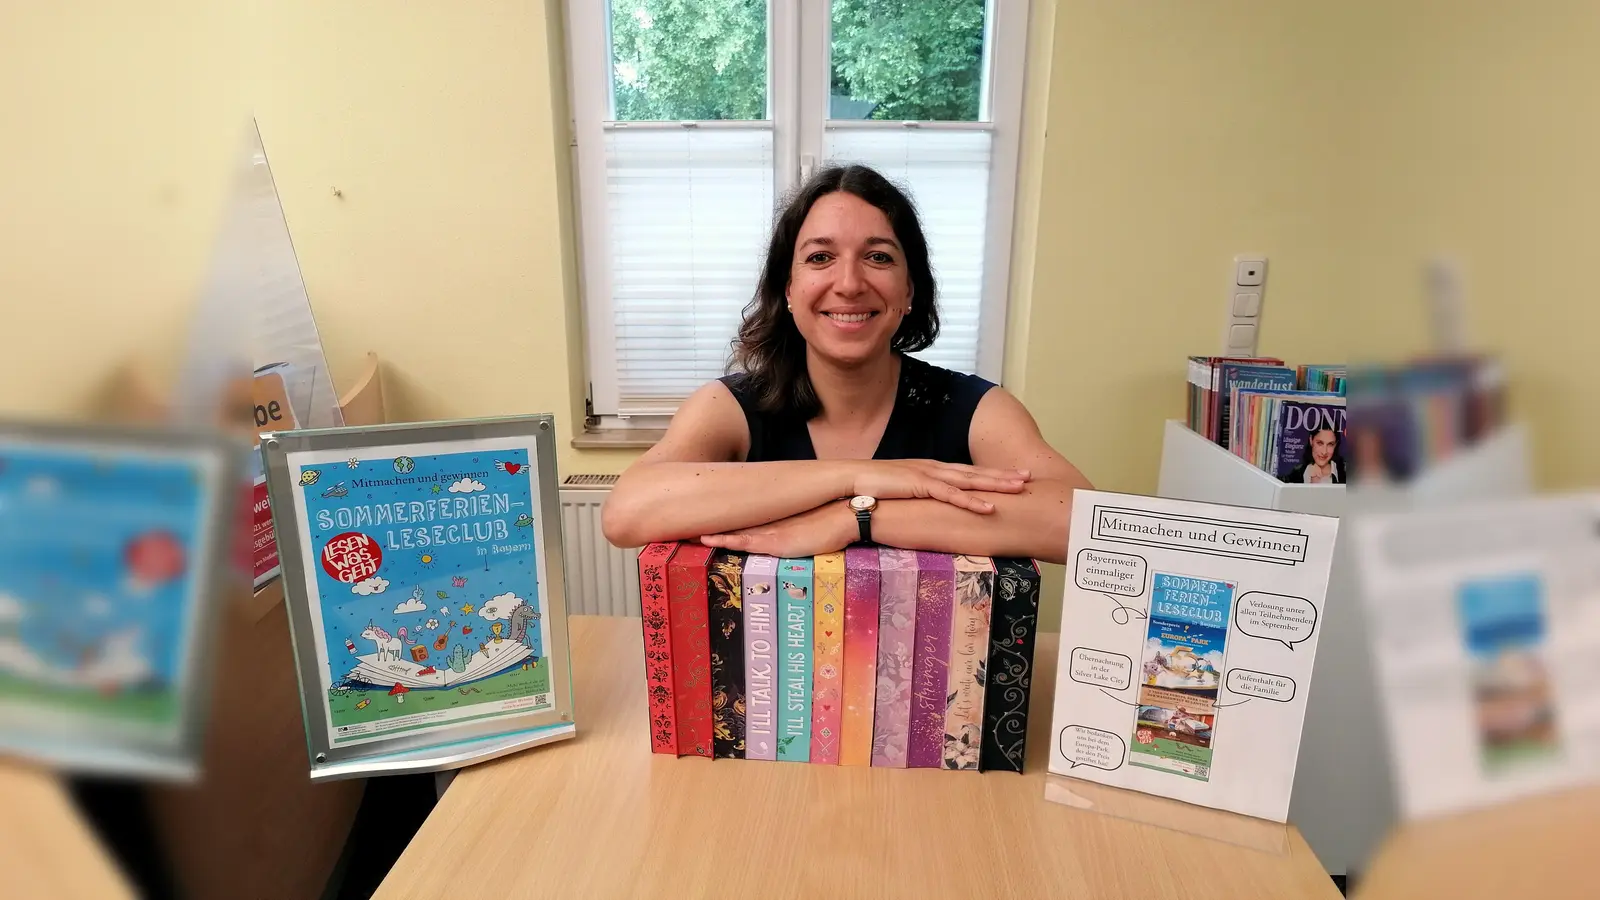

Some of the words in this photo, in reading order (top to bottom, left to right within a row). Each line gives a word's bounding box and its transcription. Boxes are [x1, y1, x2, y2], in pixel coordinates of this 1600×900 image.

[1229, 378, 1293, 391] wanderlust
[352, 476, 415, 489] Mitmachen
[417, 472, 438, 483] und
[440, 470, 489, 484] gewinnen
[316, 493, 525, 530] SOMMERFERIEN-
[254, 530, 275, 548] sgebü
[386, 519, 509, 551] LESECLUB
[1101, 517, 1183, 539] Mitmachen
[1188, 530, 1217, 543] und
[1222, 532, 1301, 553] Gewinnen
[324, 533, 369, 561] LESEN
[476, 545, 487, 556] in
[492, 542, 531, 556] Bayern
[752, 556, 772, 568] TO
[1086, 552, 1137, 567] Bayernweit
[1086, 566, 1134, 580] einmaliger
[1082, 577, 1136, 592] Sonderpreis
[1161, 575, 1225, 595] SOMMER-
[1164, 589, 1217, 606] FERIEN-
[1157, 602, 1222, 622] LESECLUB
[1240, 608, 1257, 616] allen
[1259, 610, 1313, 625] Teilnehmenden
[1249, 600, 1284, 613] Verlosung
[1285, 607, 1305, 615] unter
[750, 602, 771, 634] HIM
[787, 603, 806, 648] HEART
[1261, 620, 1299, 632] September
[1161, 632, 1187, 642] EUROPA
[1190, 637, 1208, 645] PARK
[751, 638, 772, 661] TO
[787, 651, 805, 675] HIS
[1079, 652, 1124, 669] Übernachtung
[1099, 665, 1110, 673] der
[914, 634, 948, 711] stronger
[1075, 669, 1092, 678] Silver
[1094, 673, 1109, 681] Lake
[1110, 676, 1124, 685] City
[1236, 673, 1274, 686] Aufenthalt
[1275, 679, 1287, 688] für
[751, 663, 773, 707] TALK
[787, 675, 805, 712] STEAL
[1253, 686, 1280, 695] Familie
[750, 709, 771, 735] I'LL
[786, 712, 804, 736] I'LL
